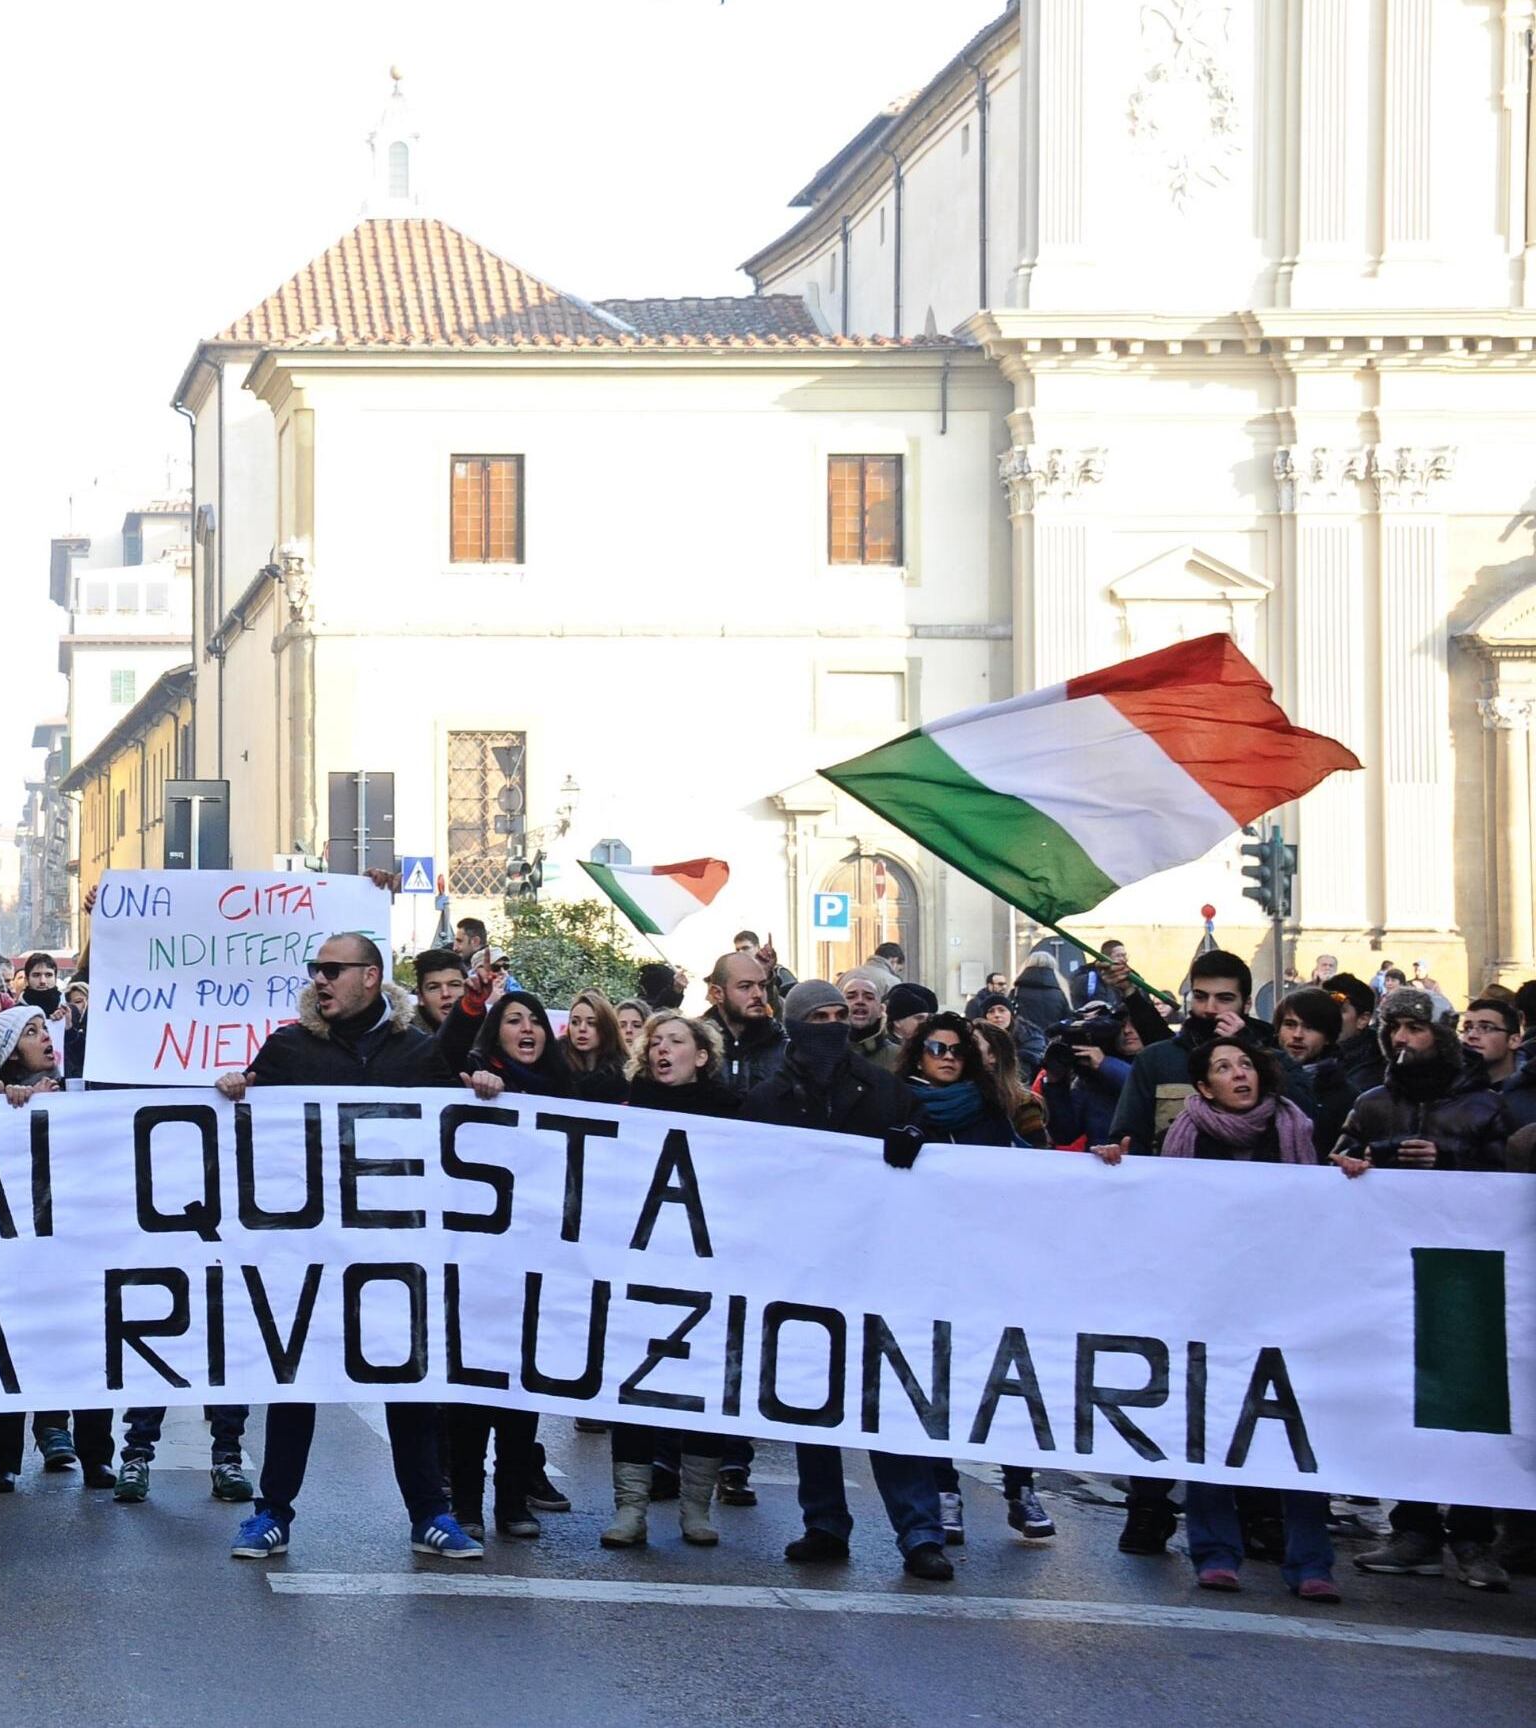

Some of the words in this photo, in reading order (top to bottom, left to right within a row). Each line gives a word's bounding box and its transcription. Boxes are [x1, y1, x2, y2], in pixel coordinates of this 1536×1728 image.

[100, 883, 171, 918] UNA
[819, 896, 843, 925] P
[148, 930, 386, 970] INDIFFERE
[105, 982, 176, 1012] NON
[196, 978, 254, 1008] PUÒ
[134, 1102, 713, 1257] QUESTA
[105, 1263, 1317, 1473] RIVOLUZIONARIA
